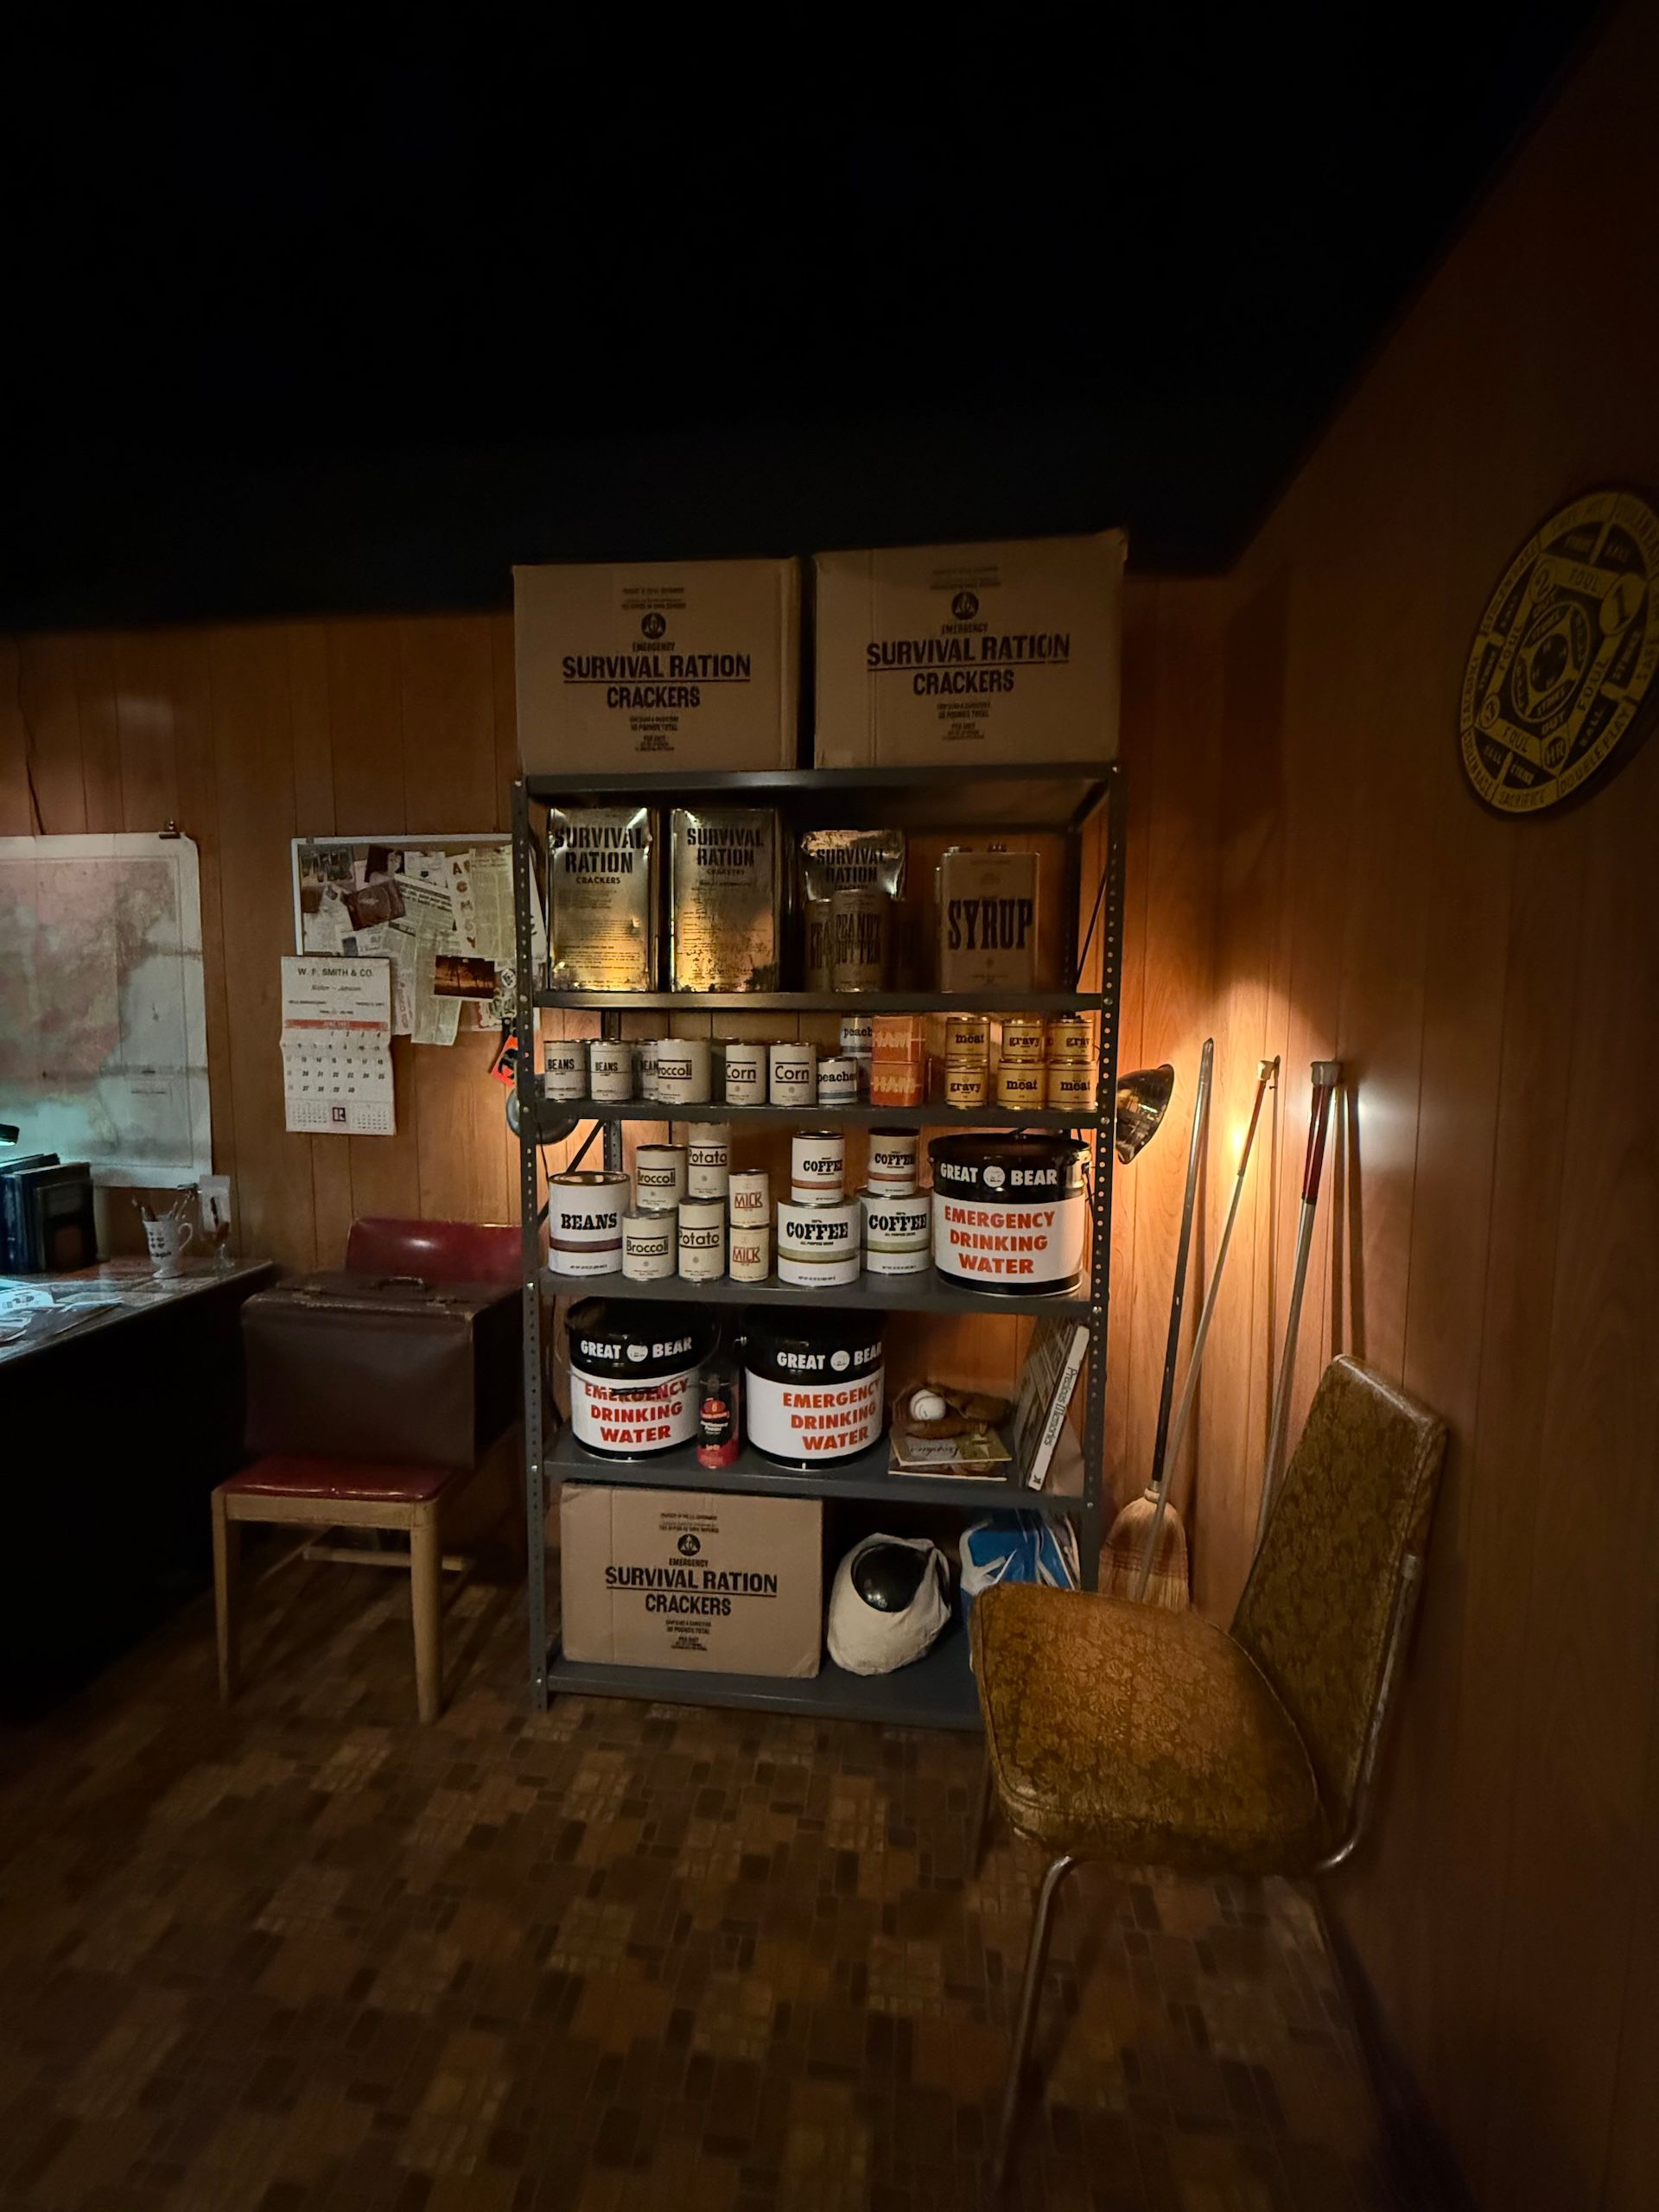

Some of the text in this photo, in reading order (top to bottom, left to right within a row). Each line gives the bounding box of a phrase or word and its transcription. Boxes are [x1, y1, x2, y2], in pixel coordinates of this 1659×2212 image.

[941, 622, 988, 635] EMERGENCY
[632, 642, 676, 652] EMERGENCY
[867, 632, 1071, 665] SURVIVAL RATION
[563, 654, 751, 678] SURVIVAL RATION
[913, 670, 1014, 695] CRACKERS
[1577, 658, 1608, 710] FOUL
[607, 686, 701, 709] CRACKERS
[1542, 712, 1567, 734] OUT
[1503, 726, 1529, 753] FOUL
[1545, 737, 1567, 768] HR
[554, 827, 645, 849] SURVIVAL
[687, 828, 764, 847] SURVIVAL
[565, 851, 633, 873] RATION
[696, 849, 754, 867] RATION
[817, 849, 887, 865] SURVIVAL
[836, 913, 882, 939] PEANUT
[948, 899, 1033, 950] SYRUP
[956, 1033, 984, 1045] meat
[1009, 1036, 1040, 1047] gravy
[548, 1058, 575, 1071] BEANS
[594, 1062, 619, 1071] BEANS
[727, 1064, 756, 1079] Corn
[775, 1065, 810, 1081] Corn
[950, 1082, 981, 1093] gravy
[1006, 1079, 1038, 1090] meat
[688, 1148, 728, 1164] Potato
[941, 1163, 1058, 1186] GREAT BEAR
[734, 1192, 762, 1208] MILK
[561, 1212, 618, 1230] BEANS
[869, 1213, 927, 1232] COFFEE
[944, 1205, 1055, 1229] EMERGENCY
[679, 1229, 720, 1246] Potato
[786, 1221, 849, 1241] COFFEE
[950, 1229, 1048, 1252] DRINKING
[626, 1237, 668, 1254] Broccoli
[733, 1247, 760, 1263] MILK
[958, 1253, 1034, 1274] WATER
[581, 1337, 692, 1360] GREAT BEAR
[777, 1351, 826, 1370] GREAT
[783, 1376, 880, 1408] EMERGENCY
[591, 1401, 683, 1422] DRINKING
[791, 1403, 876, 1429] DRINKING
[600, 1425, 671, 1444] WATER
[802, 1426, 869, 1451] WATER
[669, 1558, 709, 1568] EMERGENCY
[605, 1566, 778, 1593] SURVIVAL RATION
[645, 1593, 731, 1616] CRACKERS
